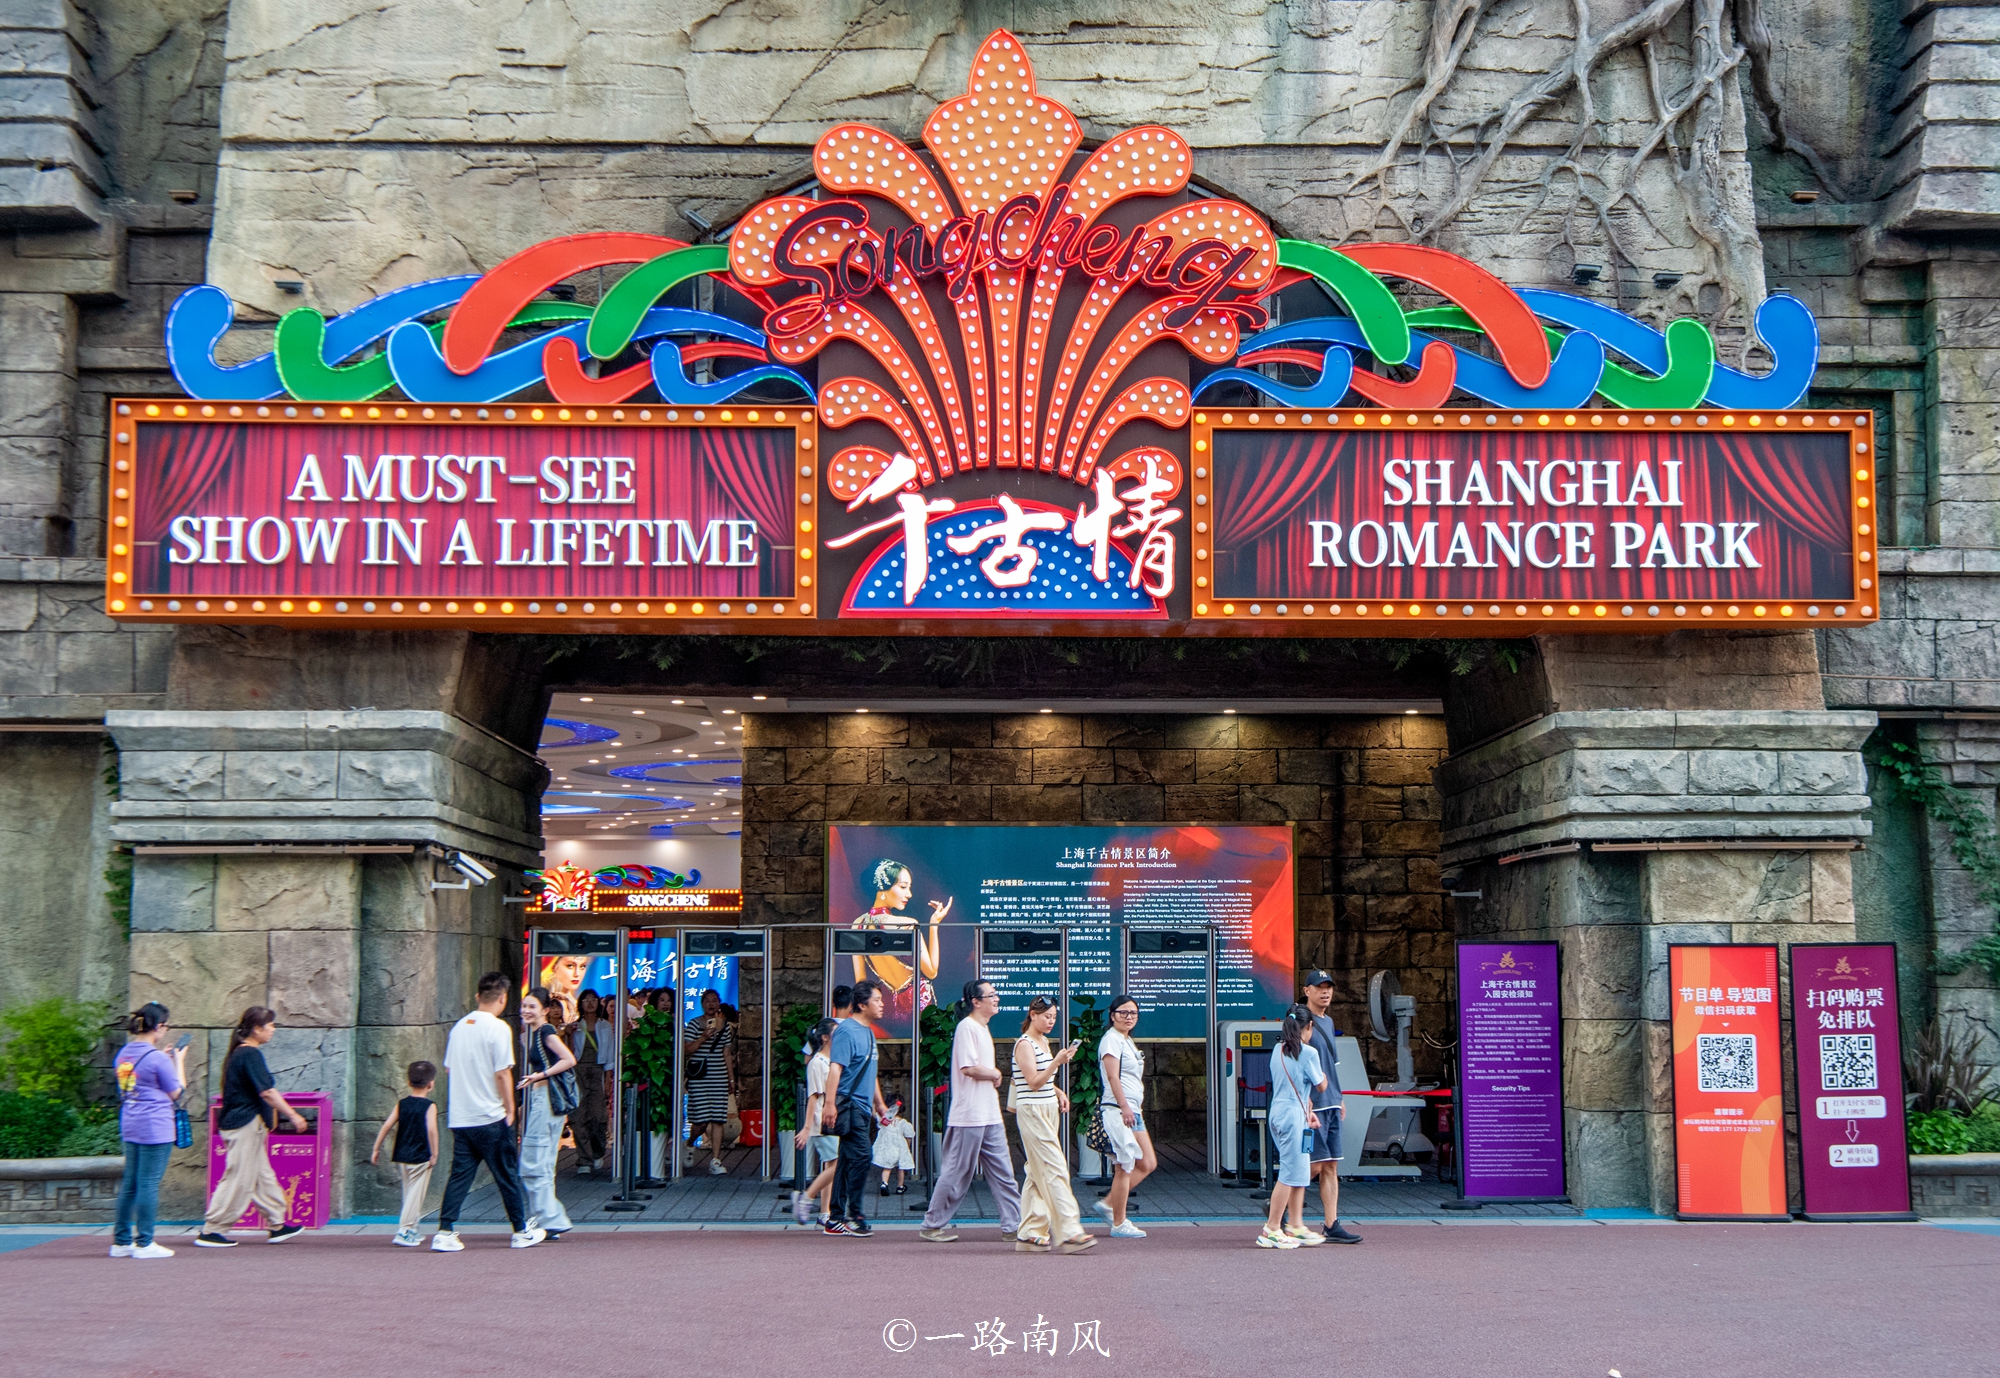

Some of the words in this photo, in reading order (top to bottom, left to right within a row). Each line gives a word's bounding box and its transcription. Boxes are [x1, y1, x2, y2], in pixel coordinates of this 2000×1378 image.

[287, 453, 333, 502] A
[340, 453, 637, 505] MUST-SEE
[1383, 458, 1684, 508] SHANGHAI
[825, 452, 1185, 606] 千古情
[167, 515, 350, 565] SHOW
[362, 517, 429, 566] IN
[439, 517, 484, 566] A
[494, 519, 759, 567] LIFETIME
[1307, 519, 1596, 570] ROMANCE
[1610, 521, 1762, 570] PARK
[1061, 847, 1171, 860] 上海千古情景区简介
[1055, 861, 1085, 869] Shanghai
[627, 894, 709, 907] SONGCHENG
[1480, 980, 1537, 989] 上海千古情景区
[1484, 990, 1533, 999] 入园安检须知
[1679, 987, 1724, 1002] 节目单
[1726, 987, 1772, 1002] 导览图
[1806, 987, 1885, 1008] 扫码购票
[1694, 1005, 1757, 1015] 微信扫码获取
[1817, 1009, 1876, 1029] 免排队
[1821, 1101, 1829, 1115] 1
[1834, 1149, 1843, 1163] 2
